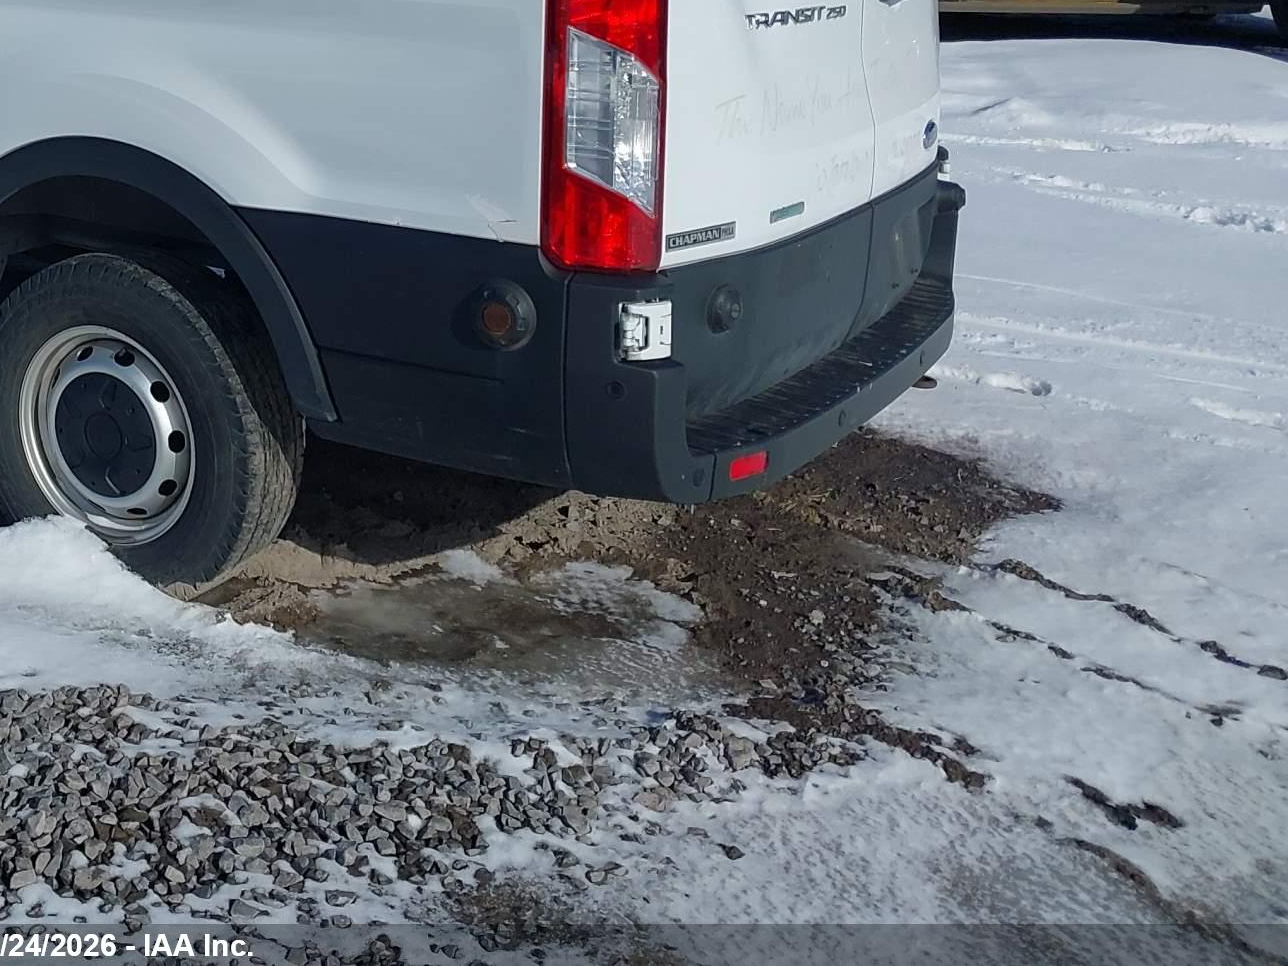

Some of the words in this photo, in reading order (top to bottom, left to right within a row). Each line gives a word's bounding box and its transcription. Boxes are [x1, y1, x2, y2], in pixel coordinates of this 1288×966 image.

[745, 5, 826, 29] TRANSIT
[826, 5, 846, 20] 250
[669, 227, 720, 248] CHAPMAN
